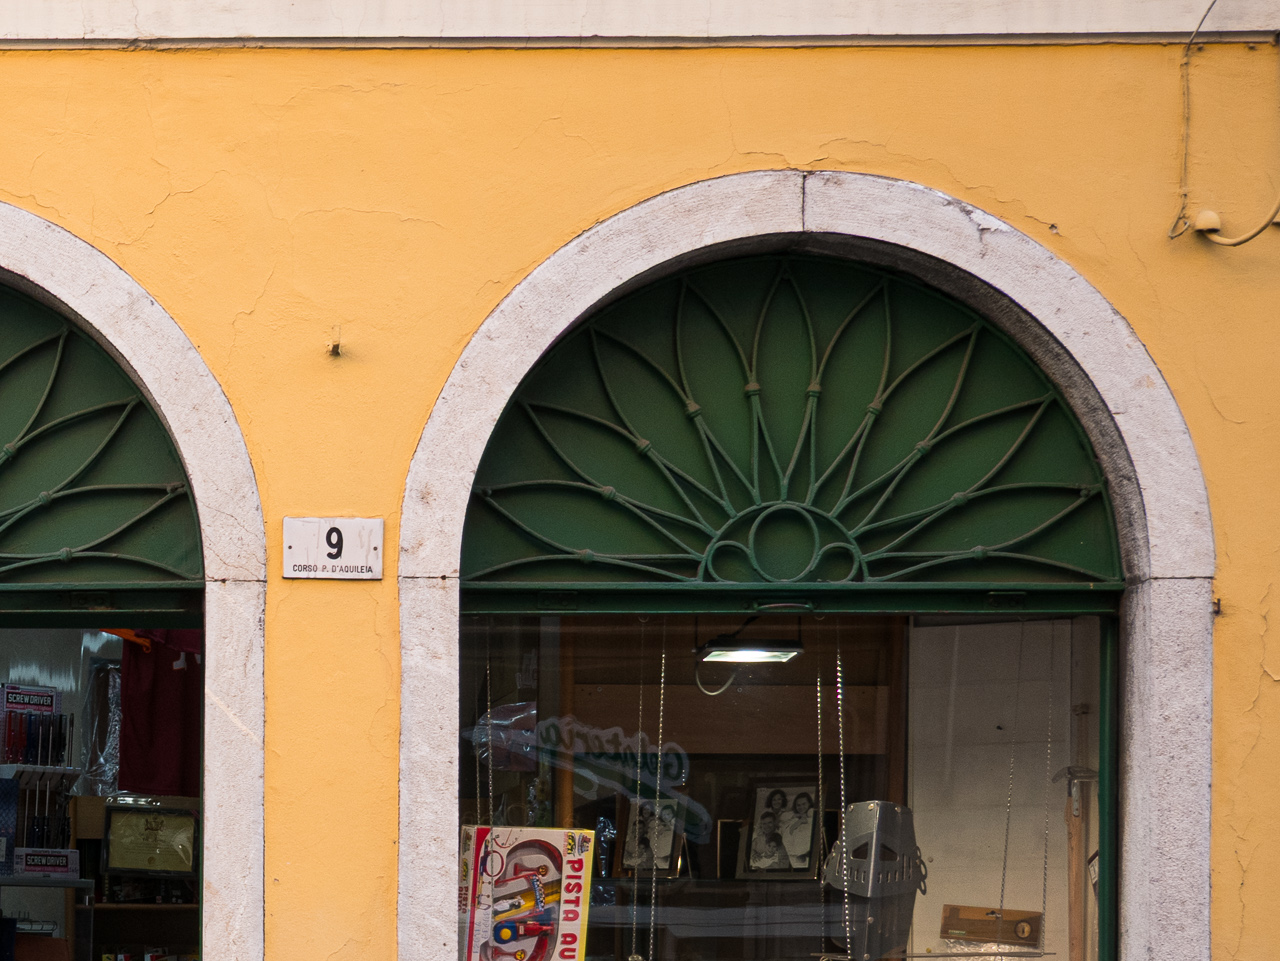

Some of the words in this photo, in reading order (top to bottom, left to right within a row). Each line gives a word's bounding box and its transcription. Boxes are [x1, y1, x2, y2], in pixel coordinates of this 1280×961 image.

[325, 526, 344, 560] 9
[292, 564, 318, 573] CORSO
[321, 565, 329, 573] P.
[331, 565, 373, 573] D'AQUILEIA
[7, 693, 30, 704] SCREW
[30, 695, 52, 706] DRIVER
[26, 855, 47, 866] SCREW
[47, 856, 68, 866] DRIVER
[562, 857, 585, 923] PISTA
